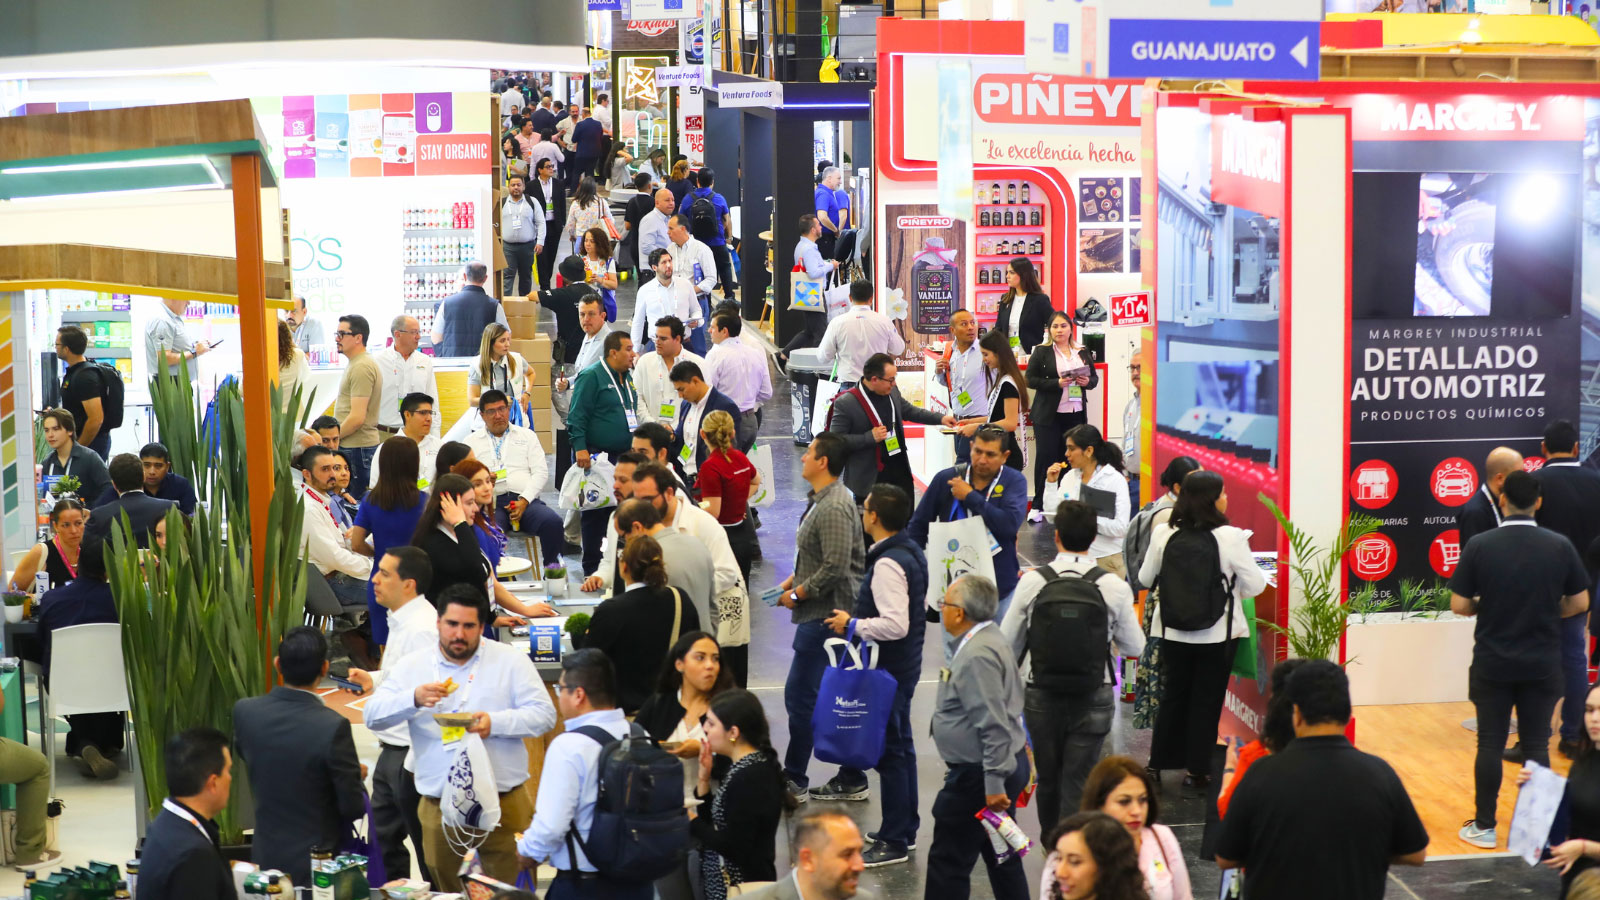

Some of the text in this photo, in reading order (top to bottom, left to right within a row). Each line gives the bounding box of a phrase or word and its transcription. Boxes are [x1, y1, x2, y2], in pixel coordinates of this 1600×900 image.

[1131, 40, 1276, 62] GUANAJUATO
[658, 71, 701, 80] Ventura Foods
[722, 89, 773, 100] Ventura Foods
[420, 143, 488, 161] STAY ORGANIC
[1008, 140, 1084, 161] excelencia
[1088, 142, 1137, 163] hecha
[900, 217, 950, 226] PIÑEYRO
[918, 291, 952, 300] VANILLA
[1369, 327, 1543, 340] MARGREY INDUSTRIAL
[1364, 344, 1538, 372] DETALLADO
[1351, 373, 1545, 401] AUTOMOTRIZ
[1361, 406, 1545, 421] PRODUCTOS QUÍMICOS
